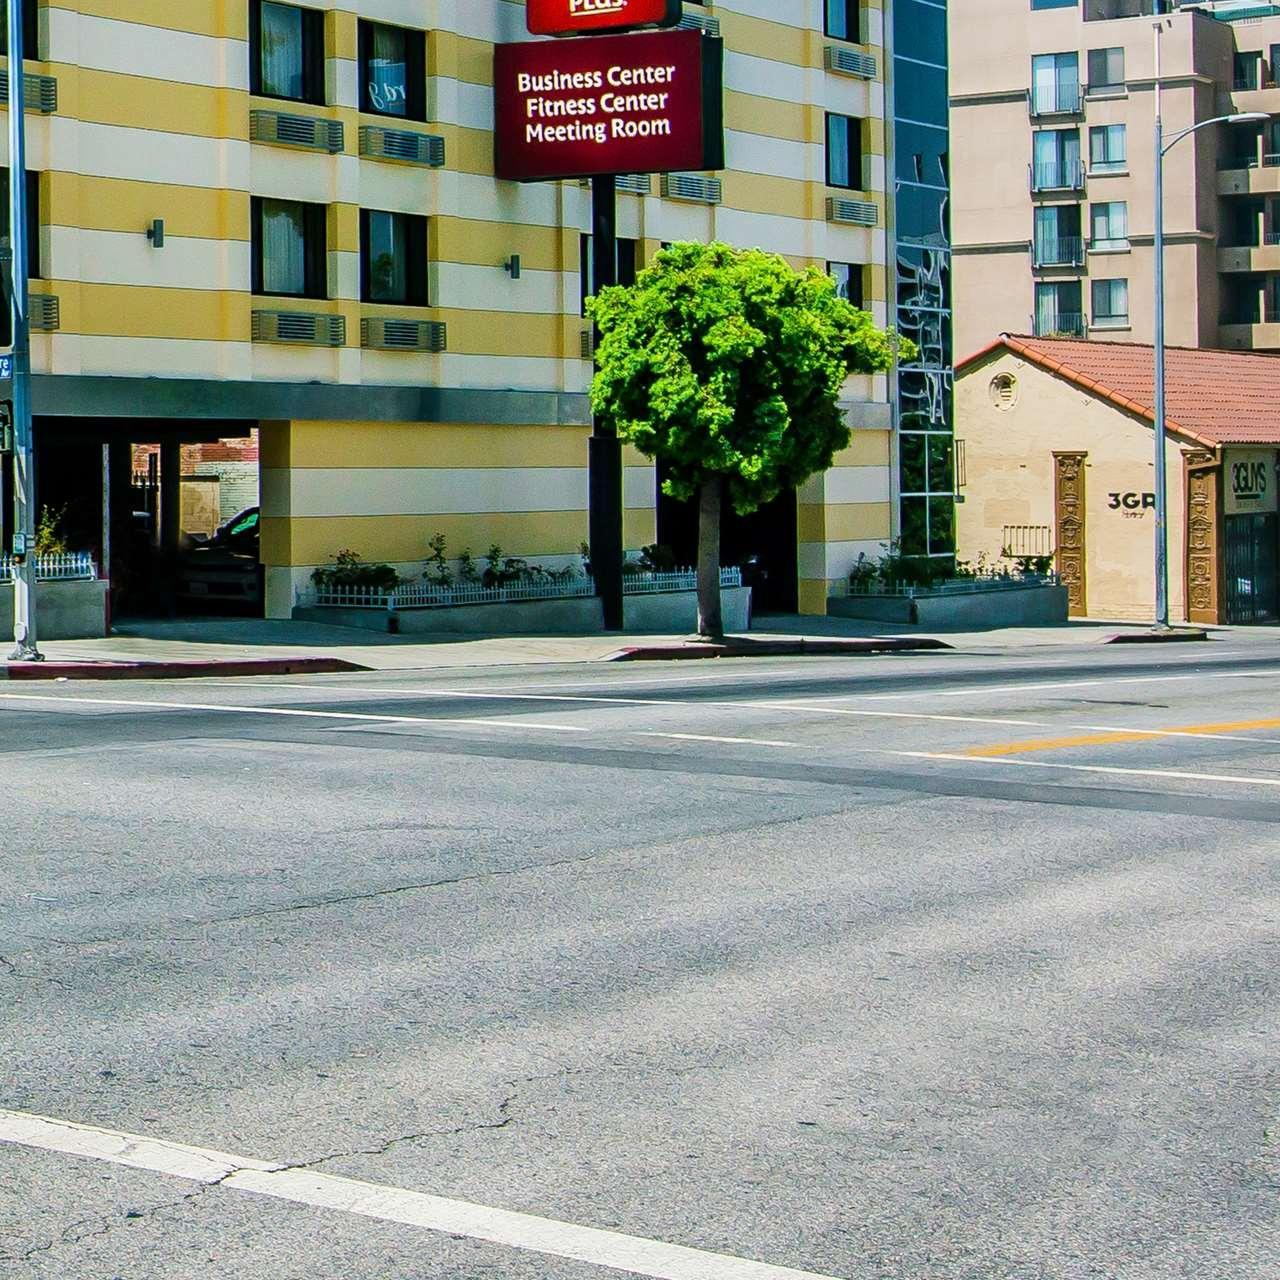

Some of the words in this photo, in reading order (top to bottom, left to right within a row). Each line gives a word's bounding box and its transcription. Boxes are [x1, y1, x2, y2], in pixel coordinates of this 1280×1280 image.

[518, 69, 602, 92] Business
[607, 66, 675, 86] Center
[526, 97, 596, 117] Fitness
[600, 93, 668, 112] Center
[526, 120, 607, 143] Meeting
[611, 118, 671, 138] Room
